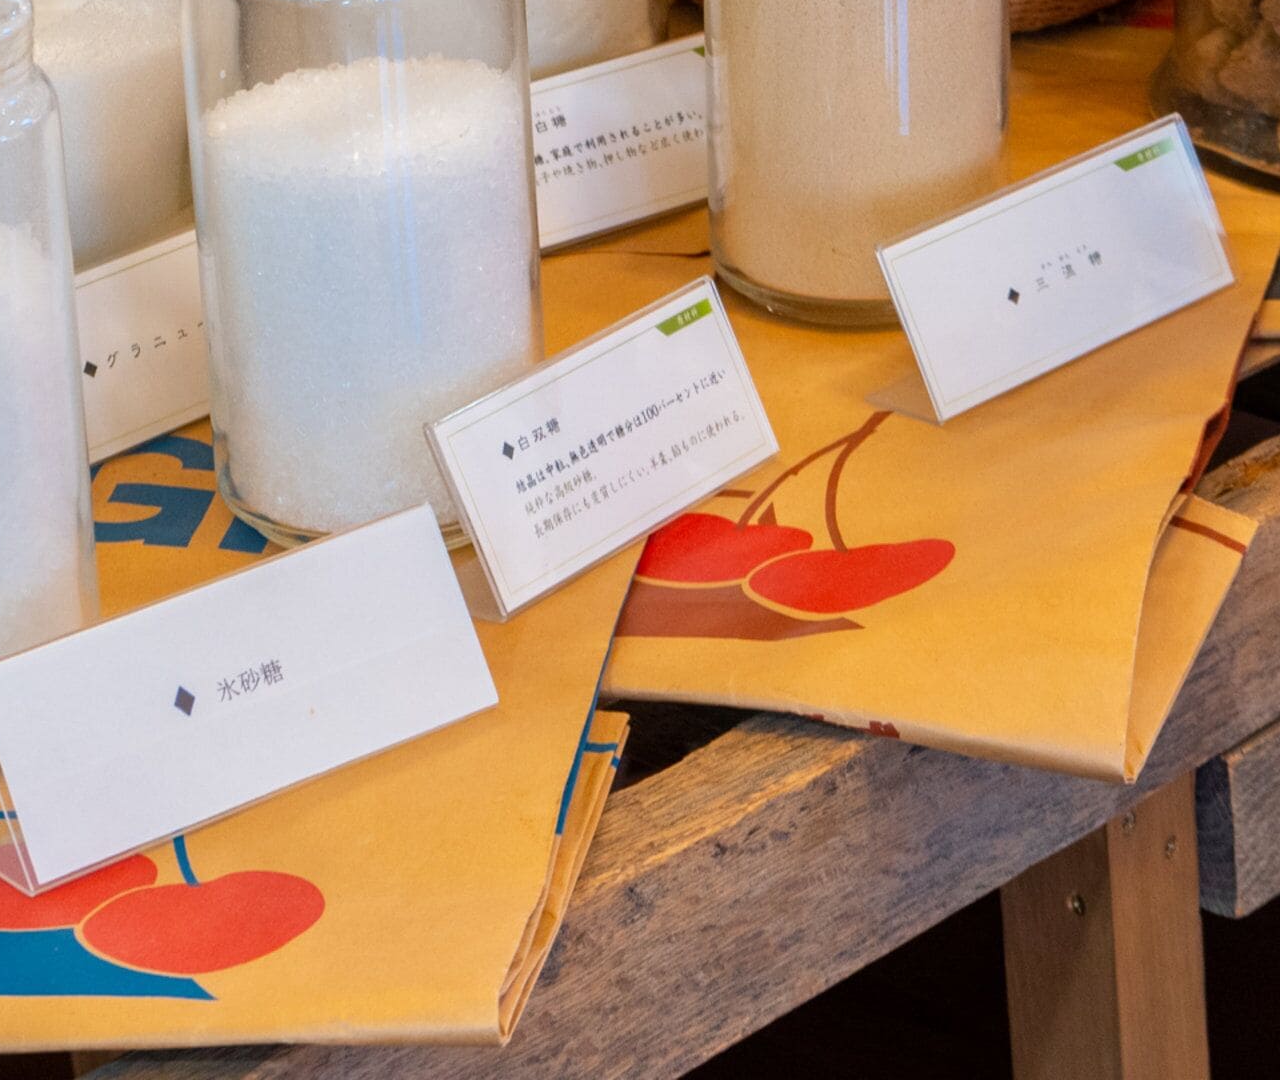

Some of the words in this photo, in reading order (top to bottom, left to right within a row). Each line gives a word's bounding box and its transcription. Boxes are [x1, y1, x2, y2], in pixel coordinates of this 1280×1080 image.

[519, 417, 562, 452] 白双糖
[217, 659, 284, 702] 氷砂糖
